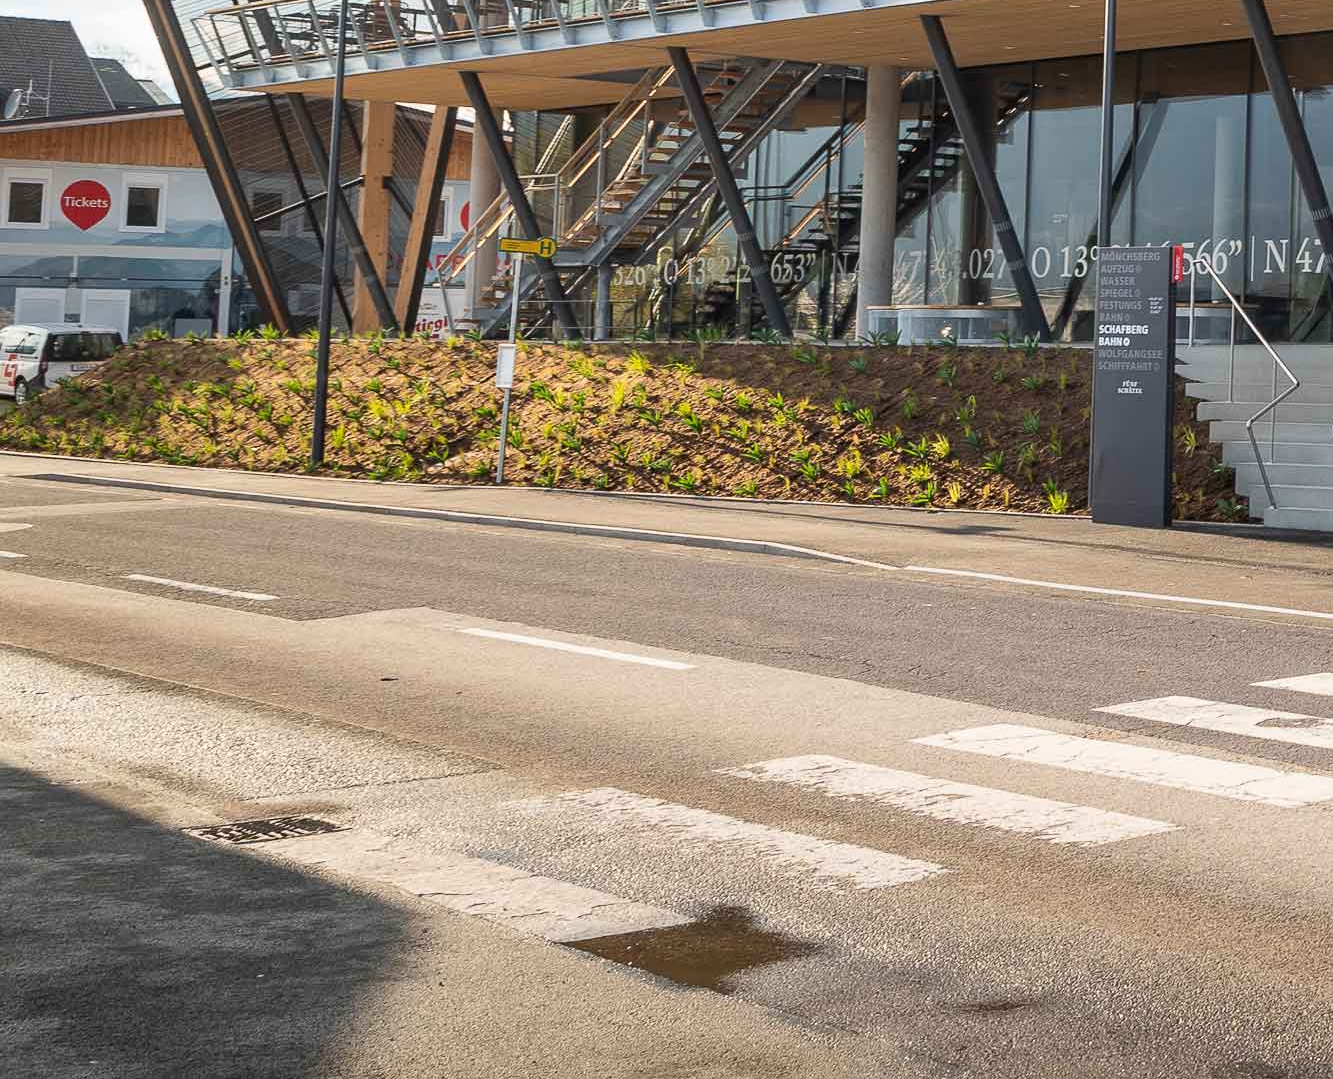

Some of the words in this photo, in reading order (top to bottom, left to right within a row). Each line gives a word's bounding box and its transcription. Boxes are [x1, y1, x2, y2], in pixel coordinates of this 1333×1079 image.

[64, 196, 109, 208] Tickets
[540, 241, 552, 255] H
[1031, 247, 1051, 278] O
[1264, 239, 1289, 273] N
[1295, 236, 1326, 273] 47
[1101, 264, 1135, 274] AUFZUG
[1100, 276, 1136, 286] WASSER
[1098, 324, 1149, 335] SCHAFBERG
[1098, 336, 1122, 346] BAHN
